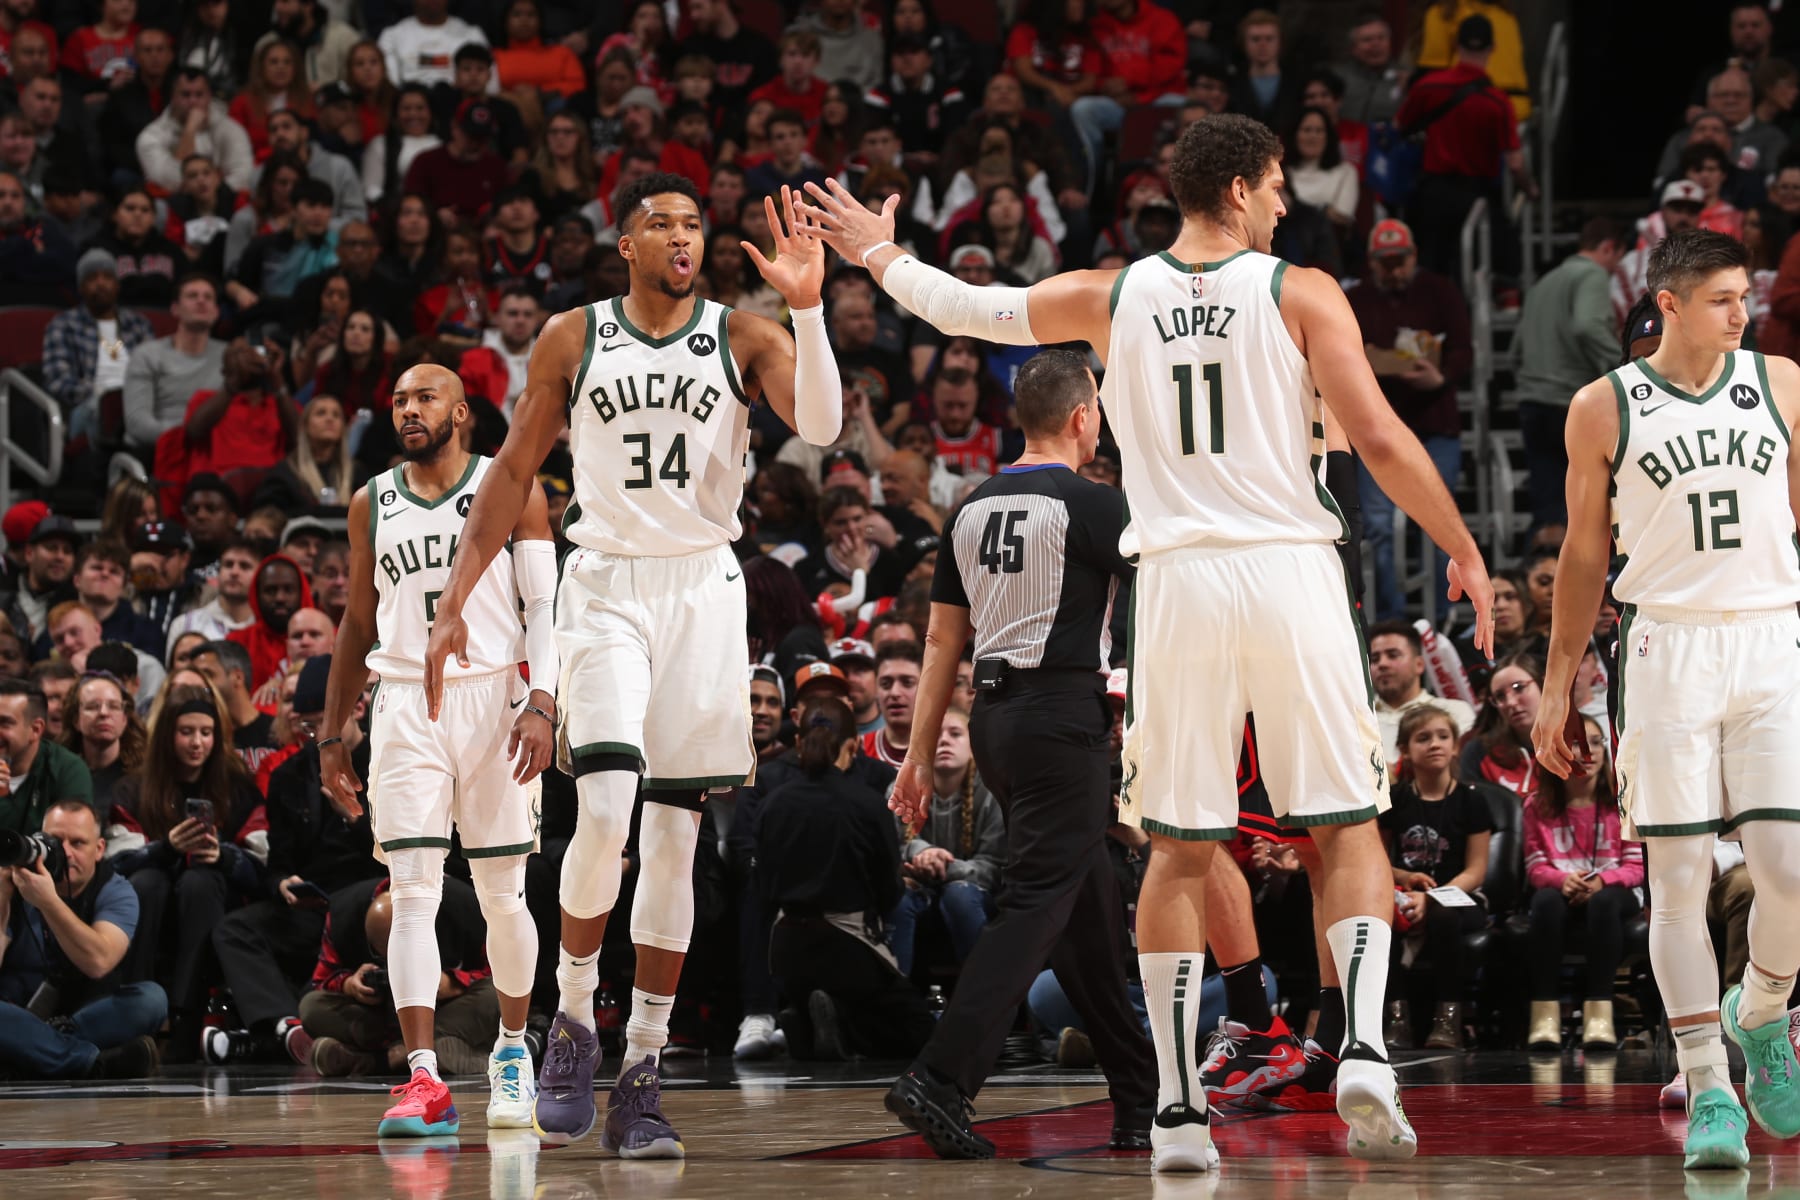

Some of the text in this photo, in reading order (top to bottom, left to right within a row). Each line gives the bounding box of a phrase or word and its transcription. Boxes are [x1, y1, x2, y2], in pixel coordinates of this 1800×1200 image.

[1153, 305, 1236, 344] LOPEZ
[589, 373, 721, 424] BUCKS
[1171, 362, 1225, 456] 11
[623, 432, 690, 490] 34
[1637, 428, 1777, 490] BUCKS
[979, 510, 1029, 574] 45
[1687, 489, 1741, 551] 12
